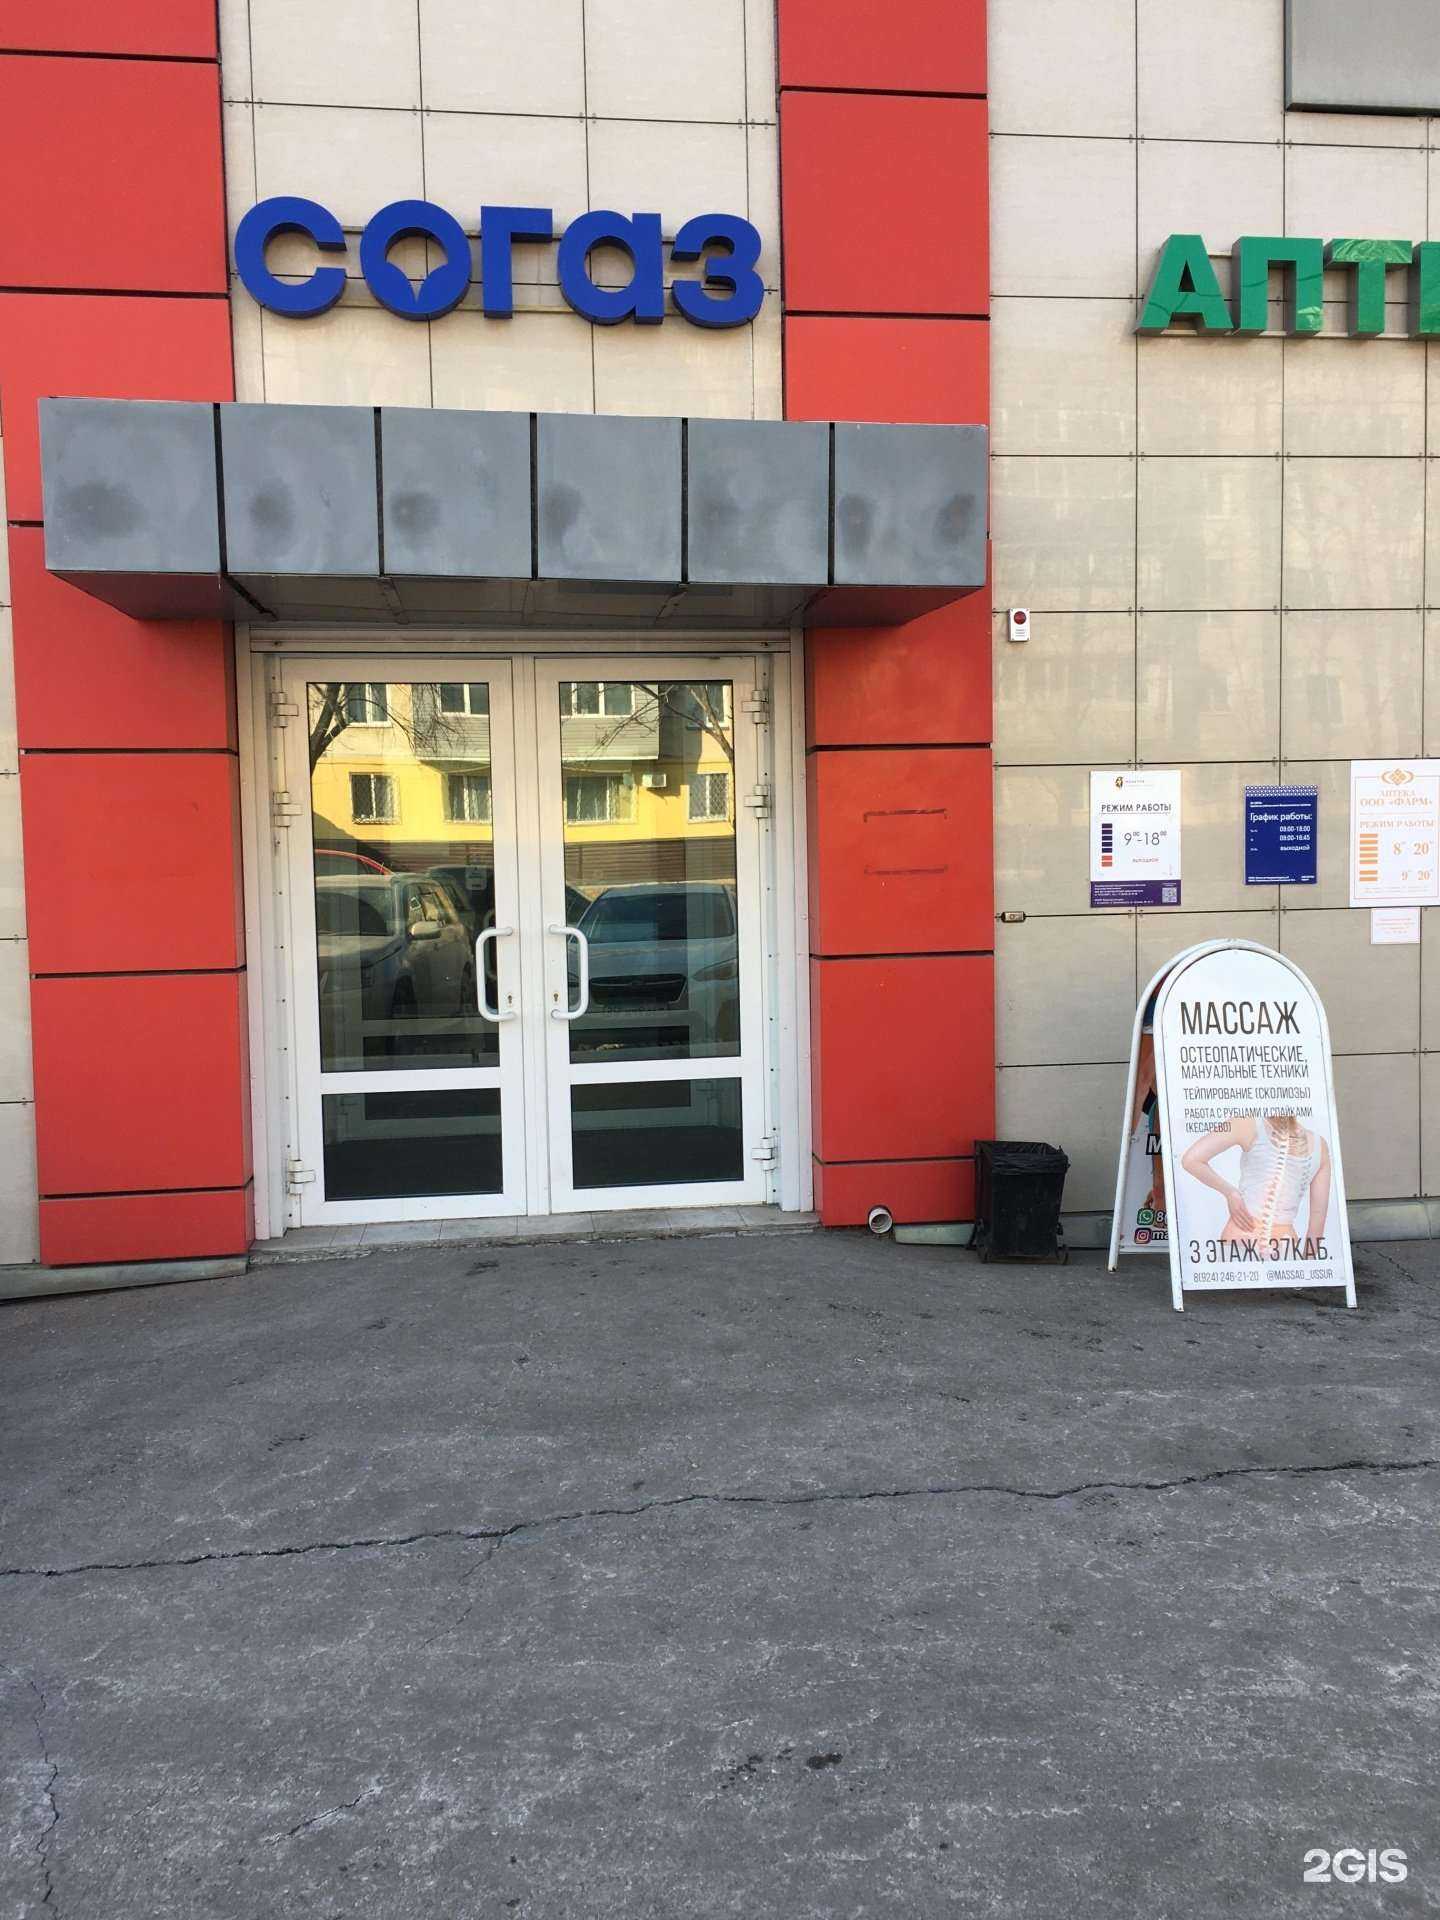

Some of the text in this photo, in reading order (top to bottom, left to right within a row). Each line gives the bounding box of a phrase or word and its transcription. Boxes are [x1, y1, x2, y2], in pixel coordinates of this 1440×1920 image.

[1101, 803, 1172, 813] РЕЖИМ РАБОТЫ
[1250, 811, 1313, 824] График работы:
[1180, 1001, 1300, 1035] МАССАЖ
[1180, 1045, 1308, 1063] ОСТЕОПАТИЧЕСКИЕ,
[1181, 1063, 1309, 1079] МАНУАЛЬНЫЕ ТЕХНИКИ
[1184, 1087, 1252, 1100] ТЕЙПИРОВАНИЕ
[1184, 1107, 1215, 1119] РАБОТА
[1216, 1108, 1222, 1118] С
[1223, 1107, 1262, 1119] РУБЦАМИ
[1263, 1106, 1269, 1118] И
[1185, 1121, 1232, 1133] (КЕСАРЕВО)
[1189, 1237, 1333, 1263] 3 ЭТАЖ, 37КАБ.
